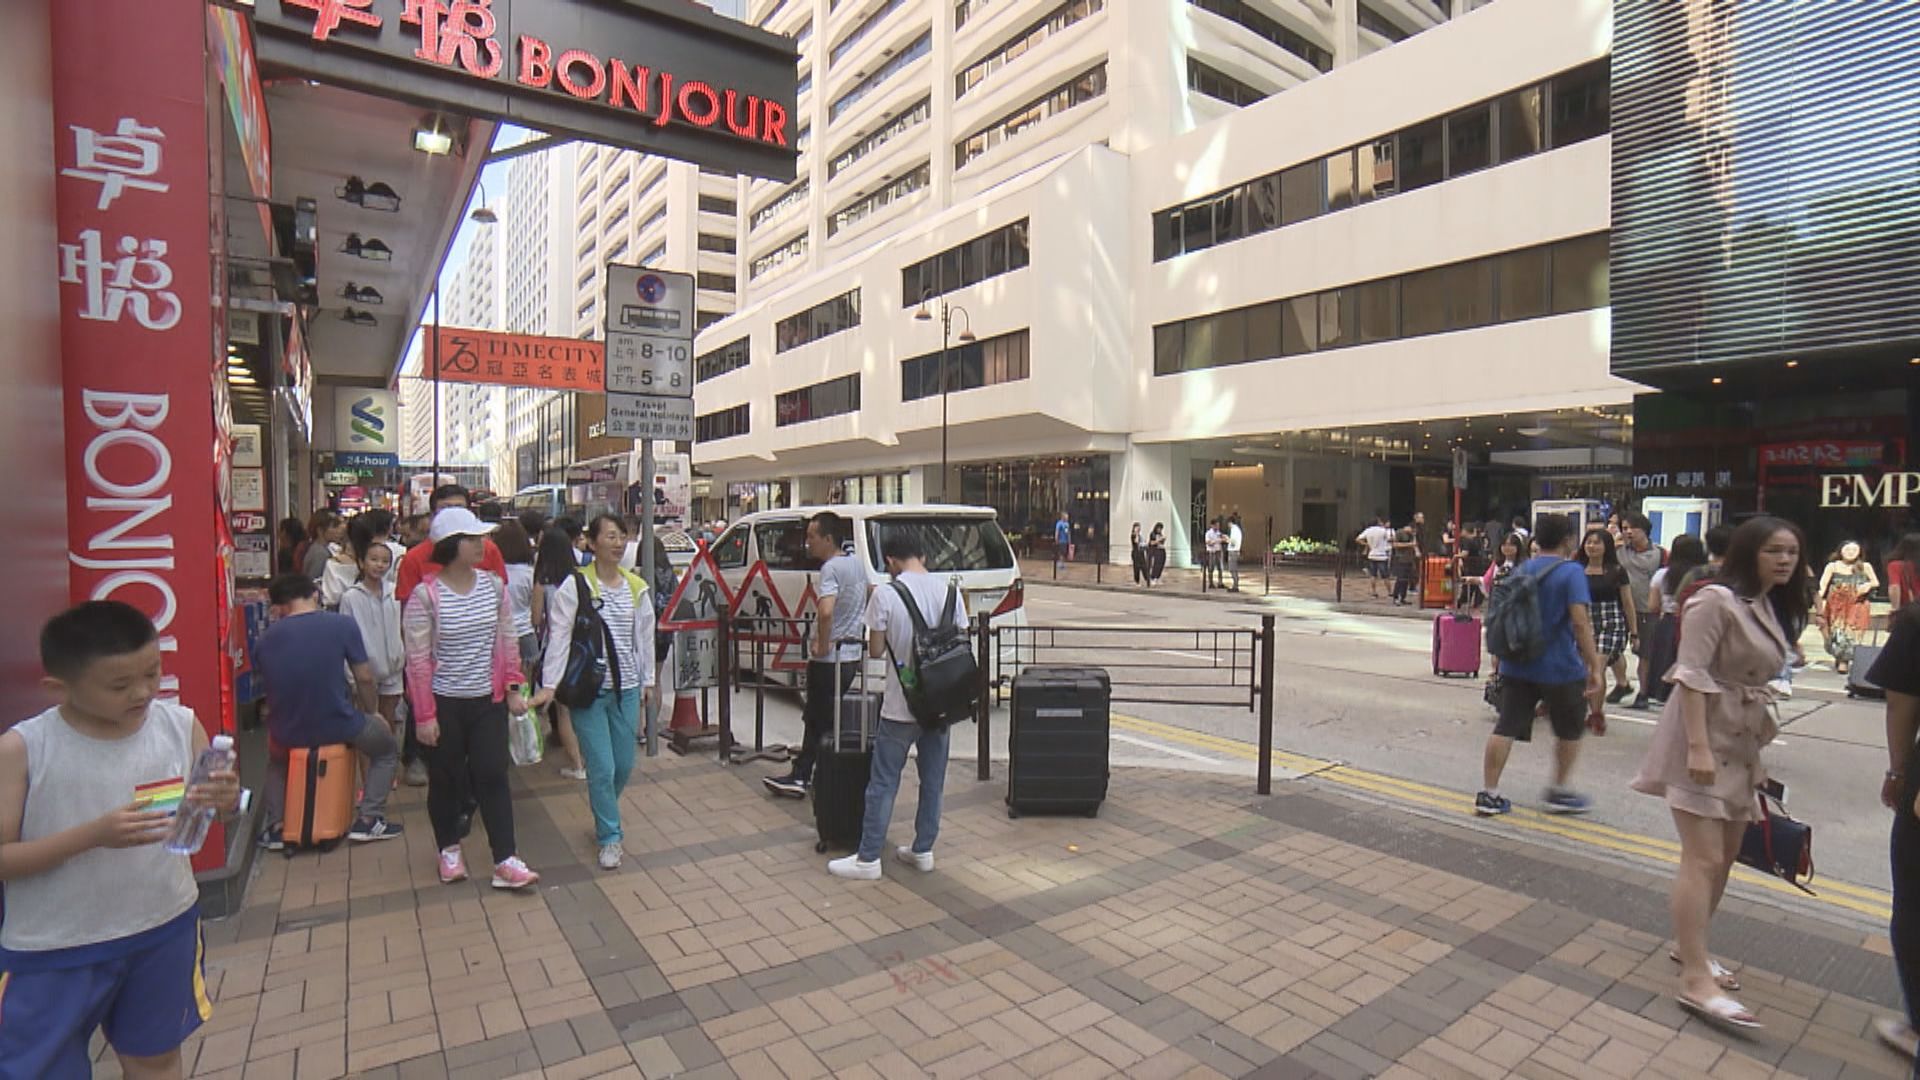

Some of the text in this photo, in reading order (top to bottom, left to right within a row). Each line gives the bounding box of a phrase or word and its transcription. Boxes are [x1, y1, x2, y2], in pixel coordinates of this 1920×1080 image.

[521, 35, 786, 146] BONJOUR
[60, 118, 182, 331] 卓悅
[484, 337, 601, 364] TIMECITY
[641, 343, 687, 362] 8-10
[486, 360, 602, 384] 冠亞名表城
[611, 408, 690, 422] General Holidays
[347, 455, 390, 465] 24-hour
